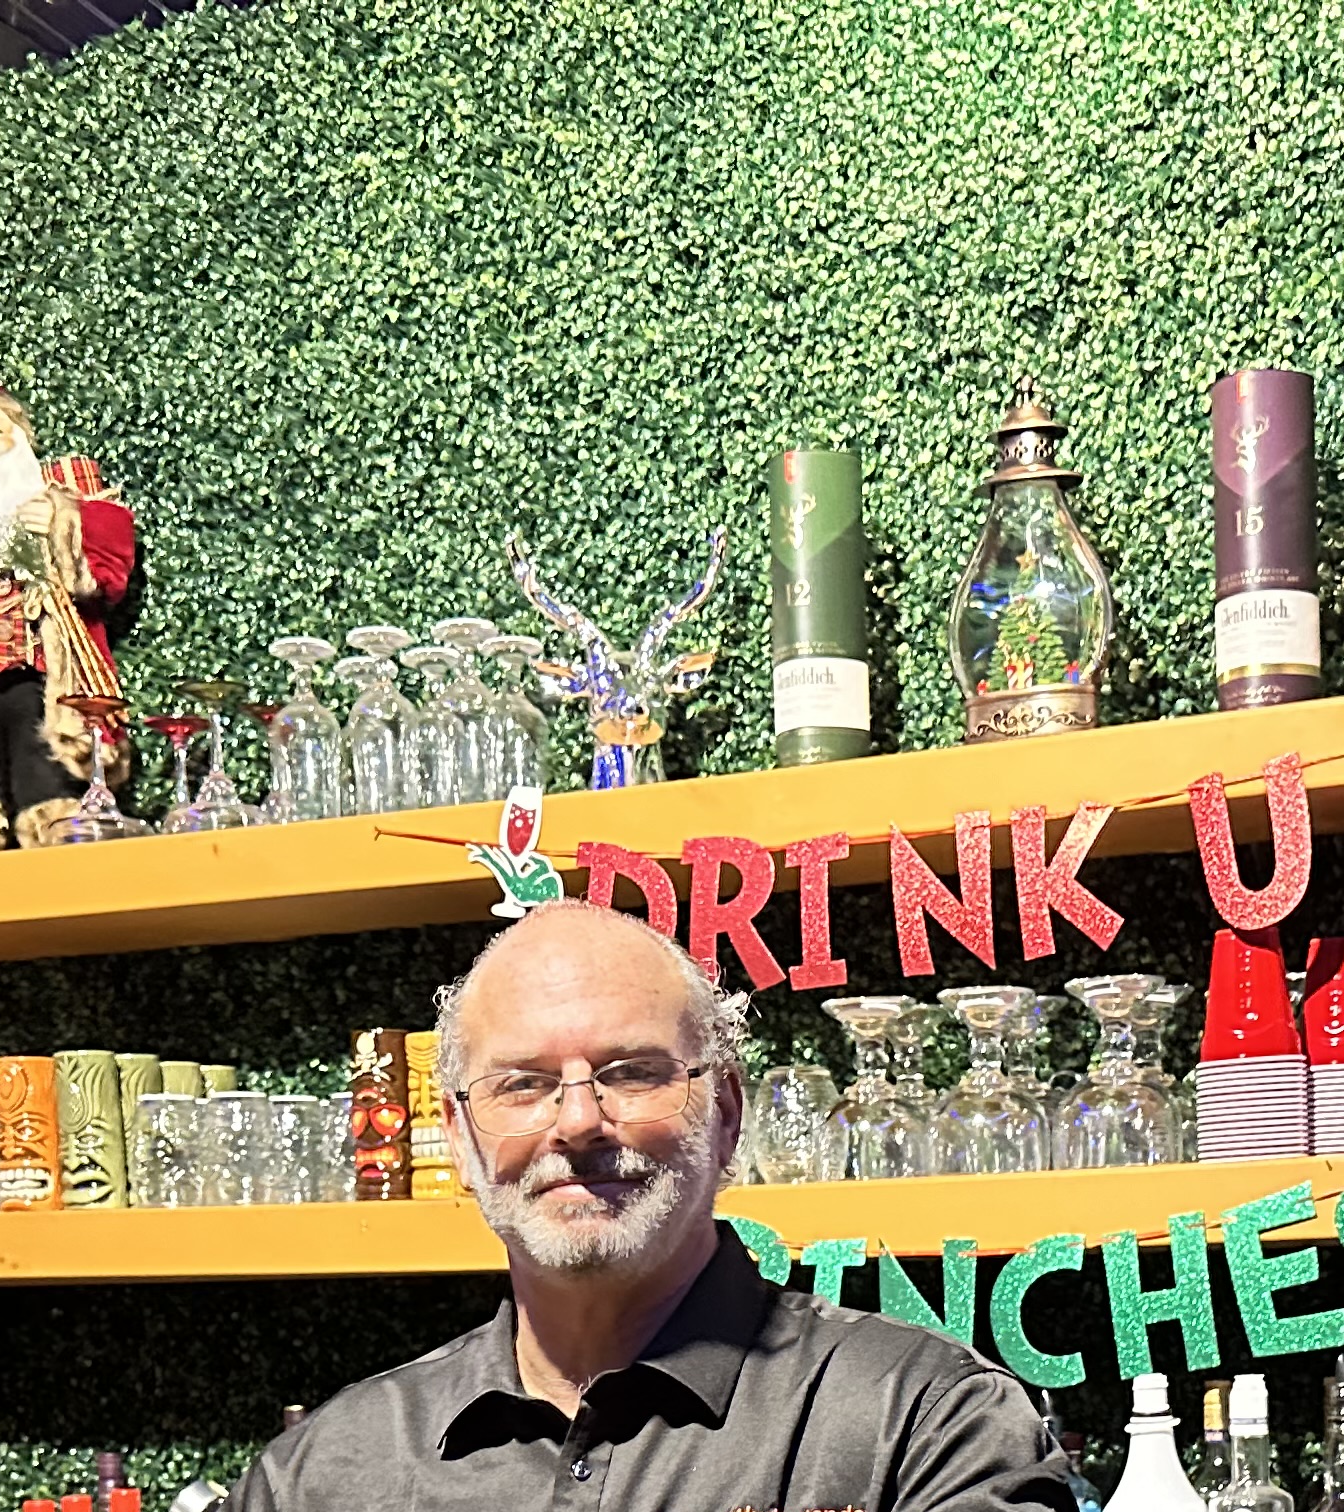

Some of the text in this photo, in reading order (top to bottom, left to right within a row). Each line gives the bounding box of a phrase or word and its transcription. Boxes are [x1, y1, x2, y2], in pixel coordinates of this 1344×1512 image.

[1234, 504, 1265, 537] 15
[785, 578, 811, 607] 12
[577, 802, 1124, 991] DRINK
